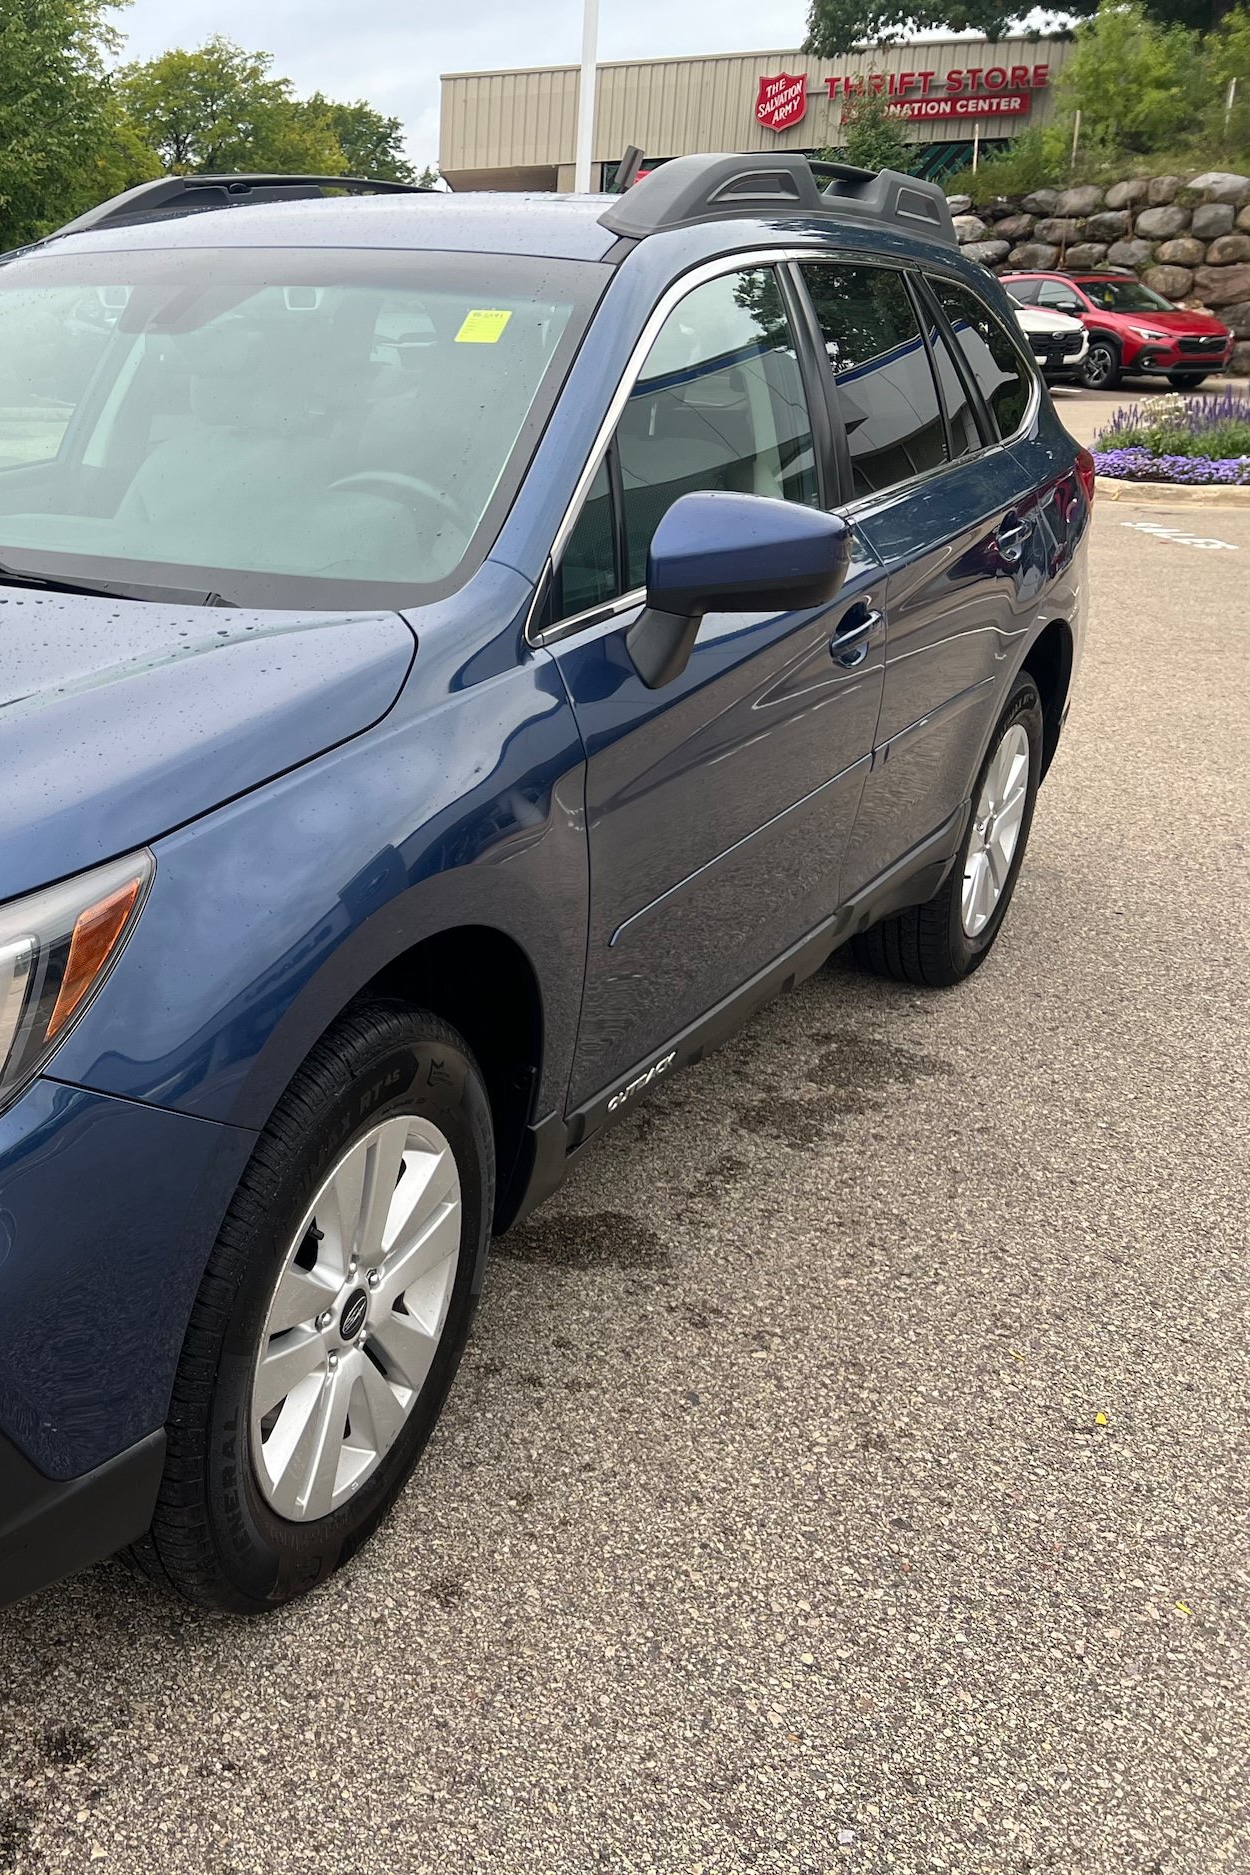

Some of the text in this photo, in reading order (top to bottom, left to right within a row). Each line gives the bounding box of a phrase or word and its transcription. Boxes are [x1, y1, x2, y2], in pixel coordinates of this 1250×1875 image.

[766, 78, 787, 98] THE
[824, 64, 1049, 101] THRIFT STORE
[757, 80, 803, 118] SALVATION
[771, 96, 801, 125] ARMY
[956, 97, 1021, 113] CENTER
